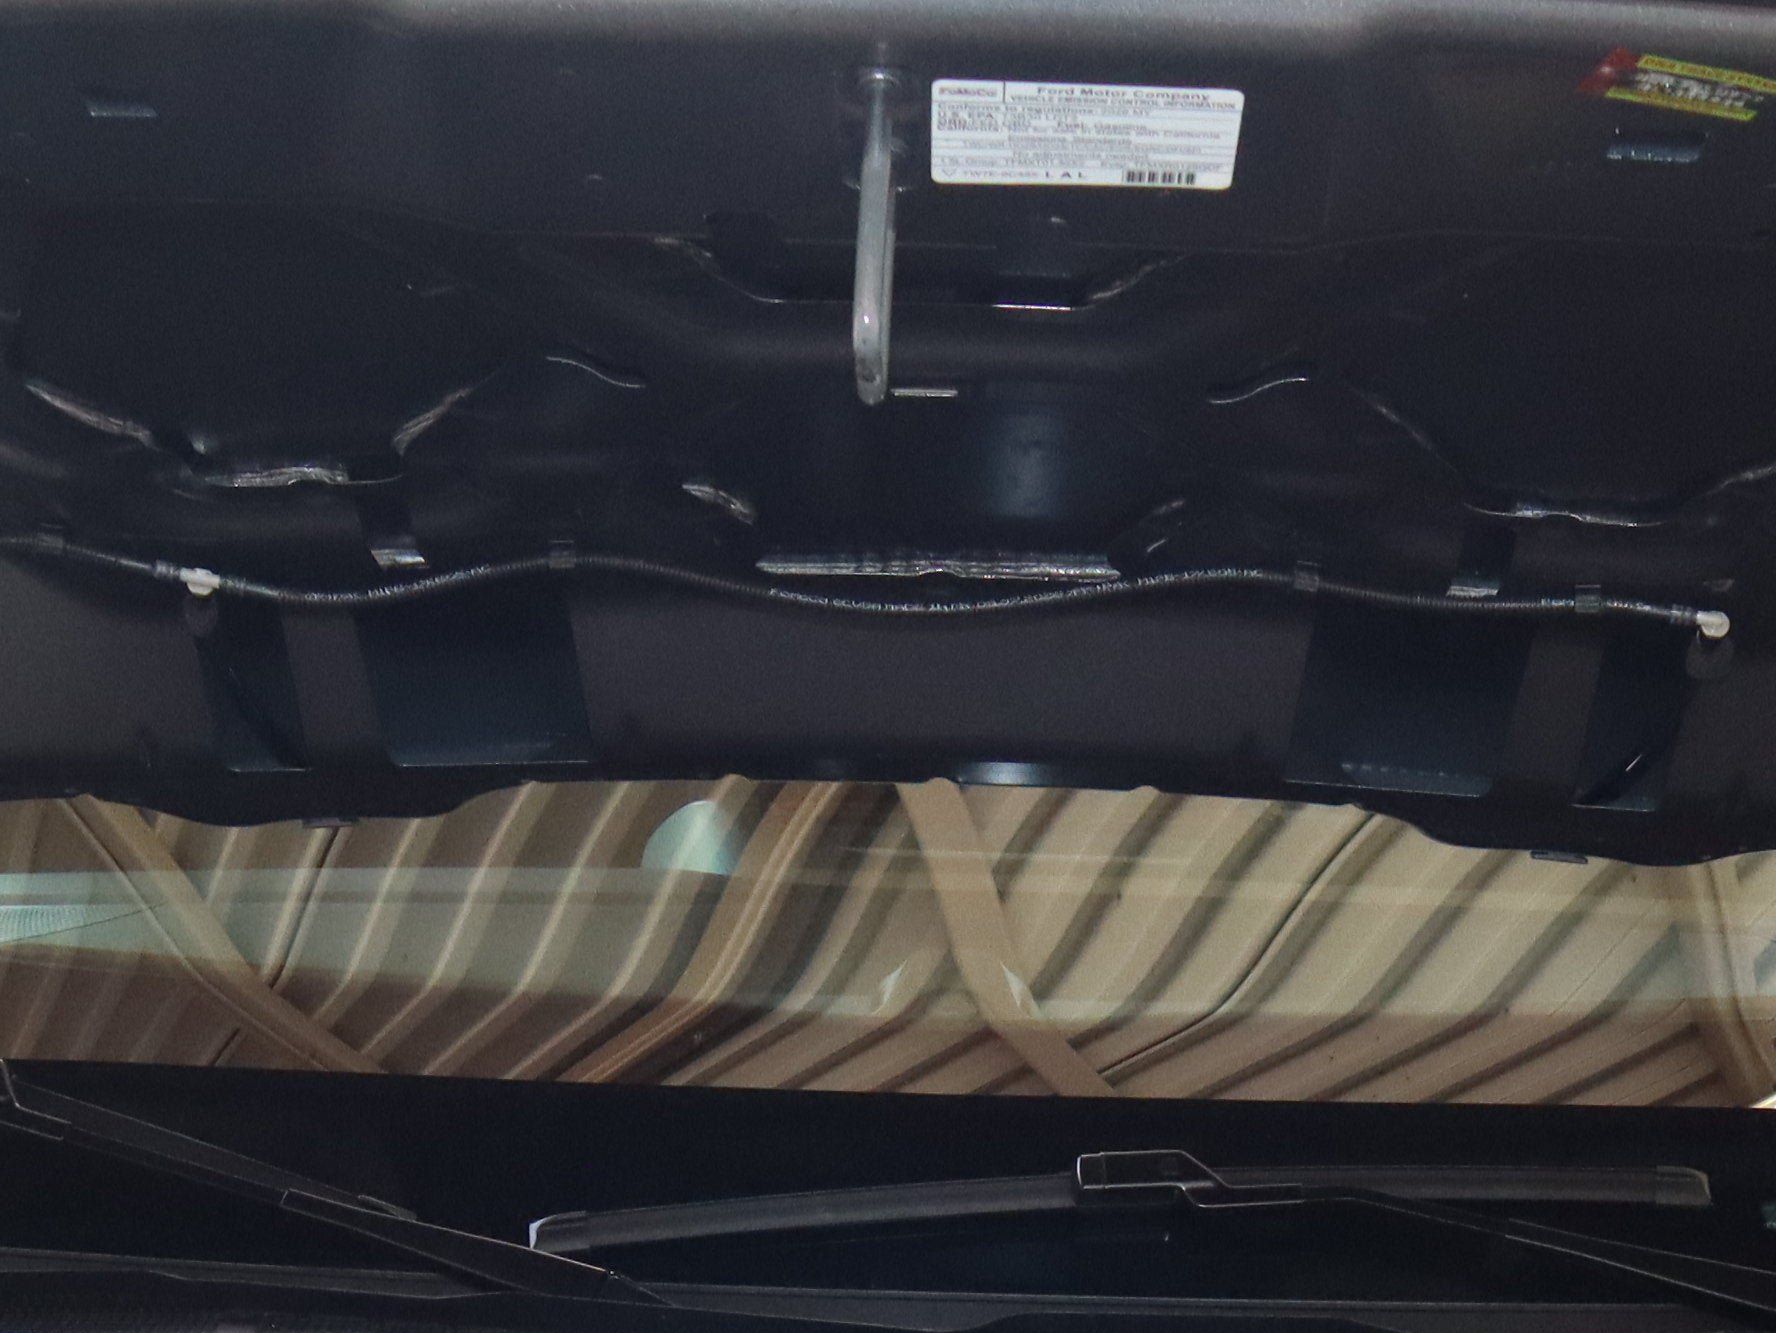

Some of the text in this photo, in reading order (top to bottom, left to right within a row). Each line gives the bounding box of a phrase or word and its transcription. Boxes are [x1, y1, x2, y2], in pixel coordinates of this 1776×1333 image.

[1036, 86, 1211, 101] Ford Motor Company
[1010, 94, 1236, 109] VEHICLE EMISSION CONTROL INFORMATION
